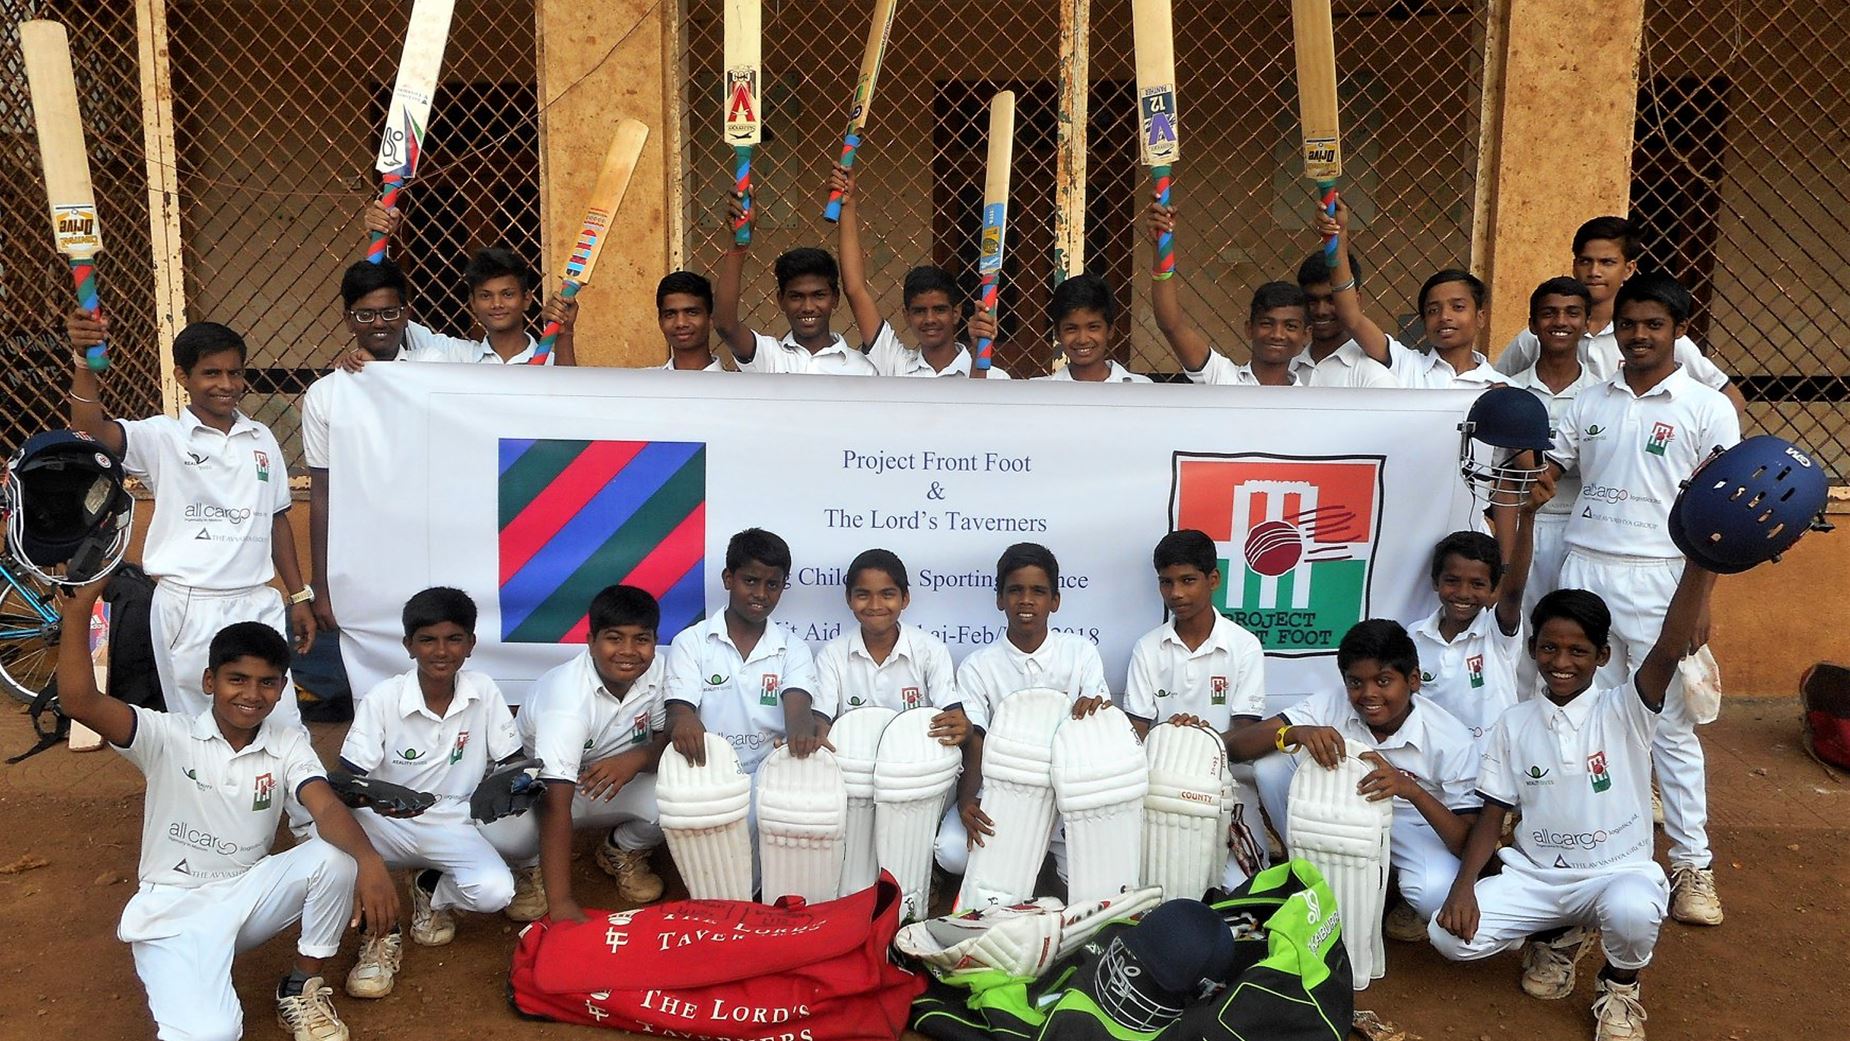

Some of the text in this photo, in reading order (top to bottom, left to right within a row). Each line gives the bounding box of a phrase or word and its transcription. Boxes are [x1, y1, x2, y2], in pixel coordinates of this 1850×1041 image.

[1145, 85, 1167, 96] PANTHER
[1150, 95, 1166, 112] 12
[1308, 150, 1335, 162] Drive
[59, 218, 94, 235] Drive
[843, 450, 1031, 474] Project Front Foot
[927, 481, 945, 500] &
[824, 509, 1047, 532] The Lord’s Taverners
[804, 621, 841, 641] Aid
[1277, 630, 1332, 645] FOOT
[1181, 791, 1212, 803] COUNTY
[640, 989, 810, 1024] THE LORD'S
